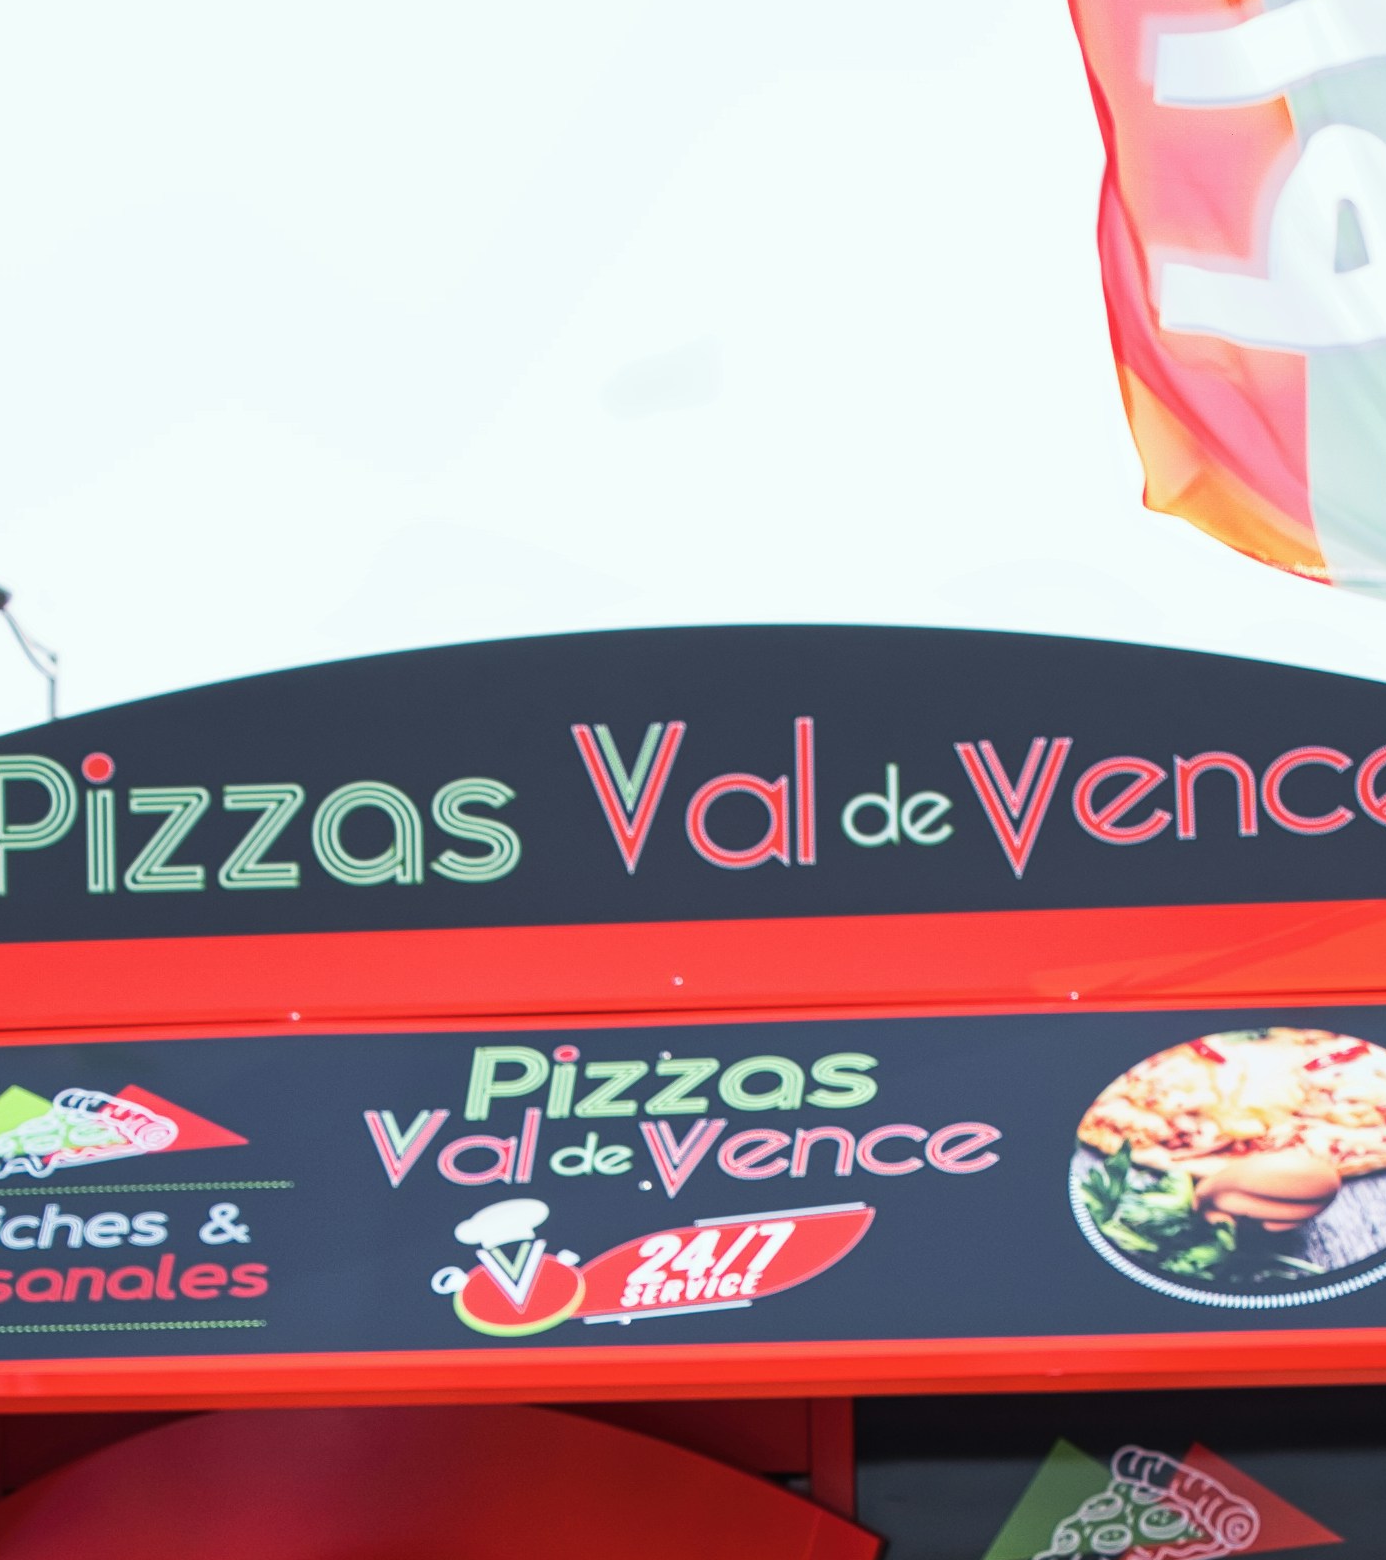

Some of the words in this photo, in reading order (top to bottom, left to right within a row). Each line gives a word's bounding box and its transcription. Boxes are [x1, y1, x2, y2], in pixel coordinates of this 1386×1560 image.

[570, 715, 817, 875] Val
[841, 762, 954, 846] de
[464, 1043, 879, 1121] Pizzas
[363, 1106, 542, 1188] Val
[549, 1131, 633, 1177] de
[639, 1118, 1002, 1199] Vence
[198, 1201, 251, 1245] &
[626, 1220, 797, 1285] 24/7
[620, 1271, 764, 1309] SERVICE
